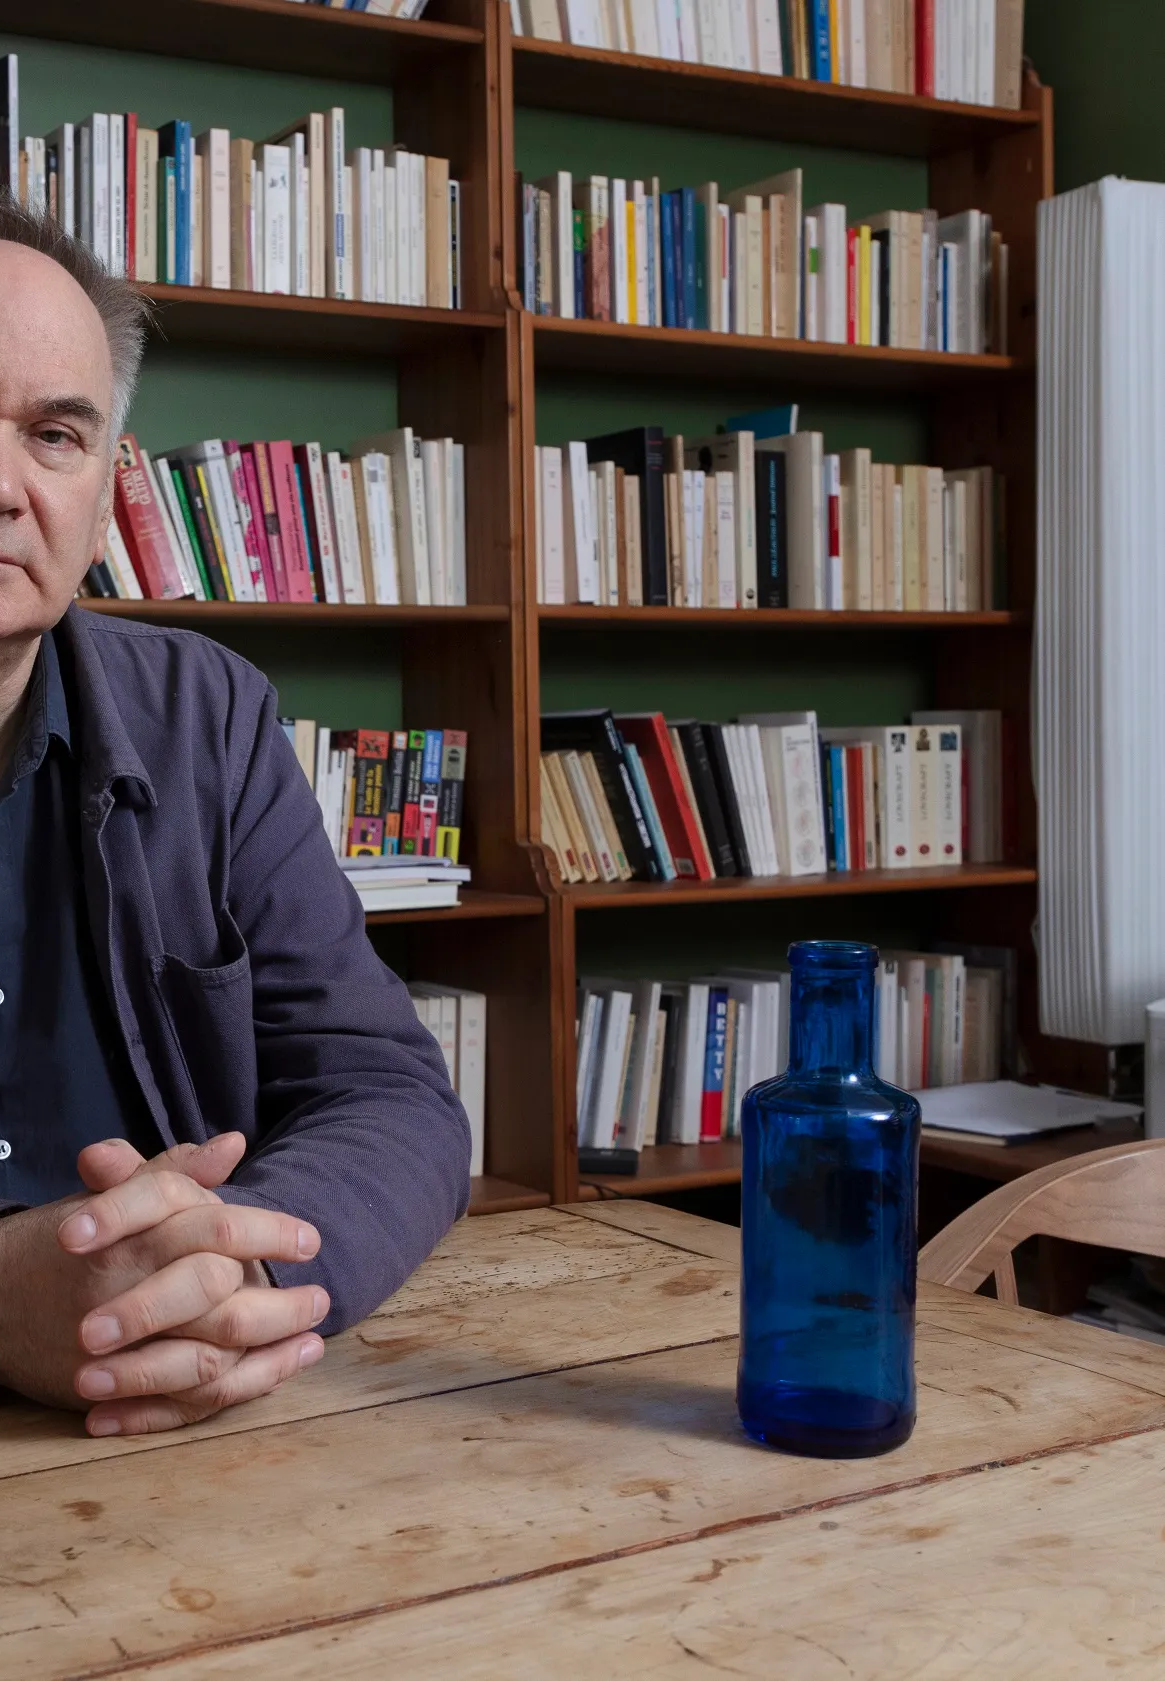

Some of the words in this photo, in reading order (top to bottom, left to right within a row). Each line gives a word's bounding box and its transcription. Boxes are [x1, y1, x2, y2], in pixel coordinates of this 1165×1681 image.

[119, 469, 139, 505] SACHA
[130, 467, 152, 507] GUITRY
[714, 1002, 727, 1081] BETTY
